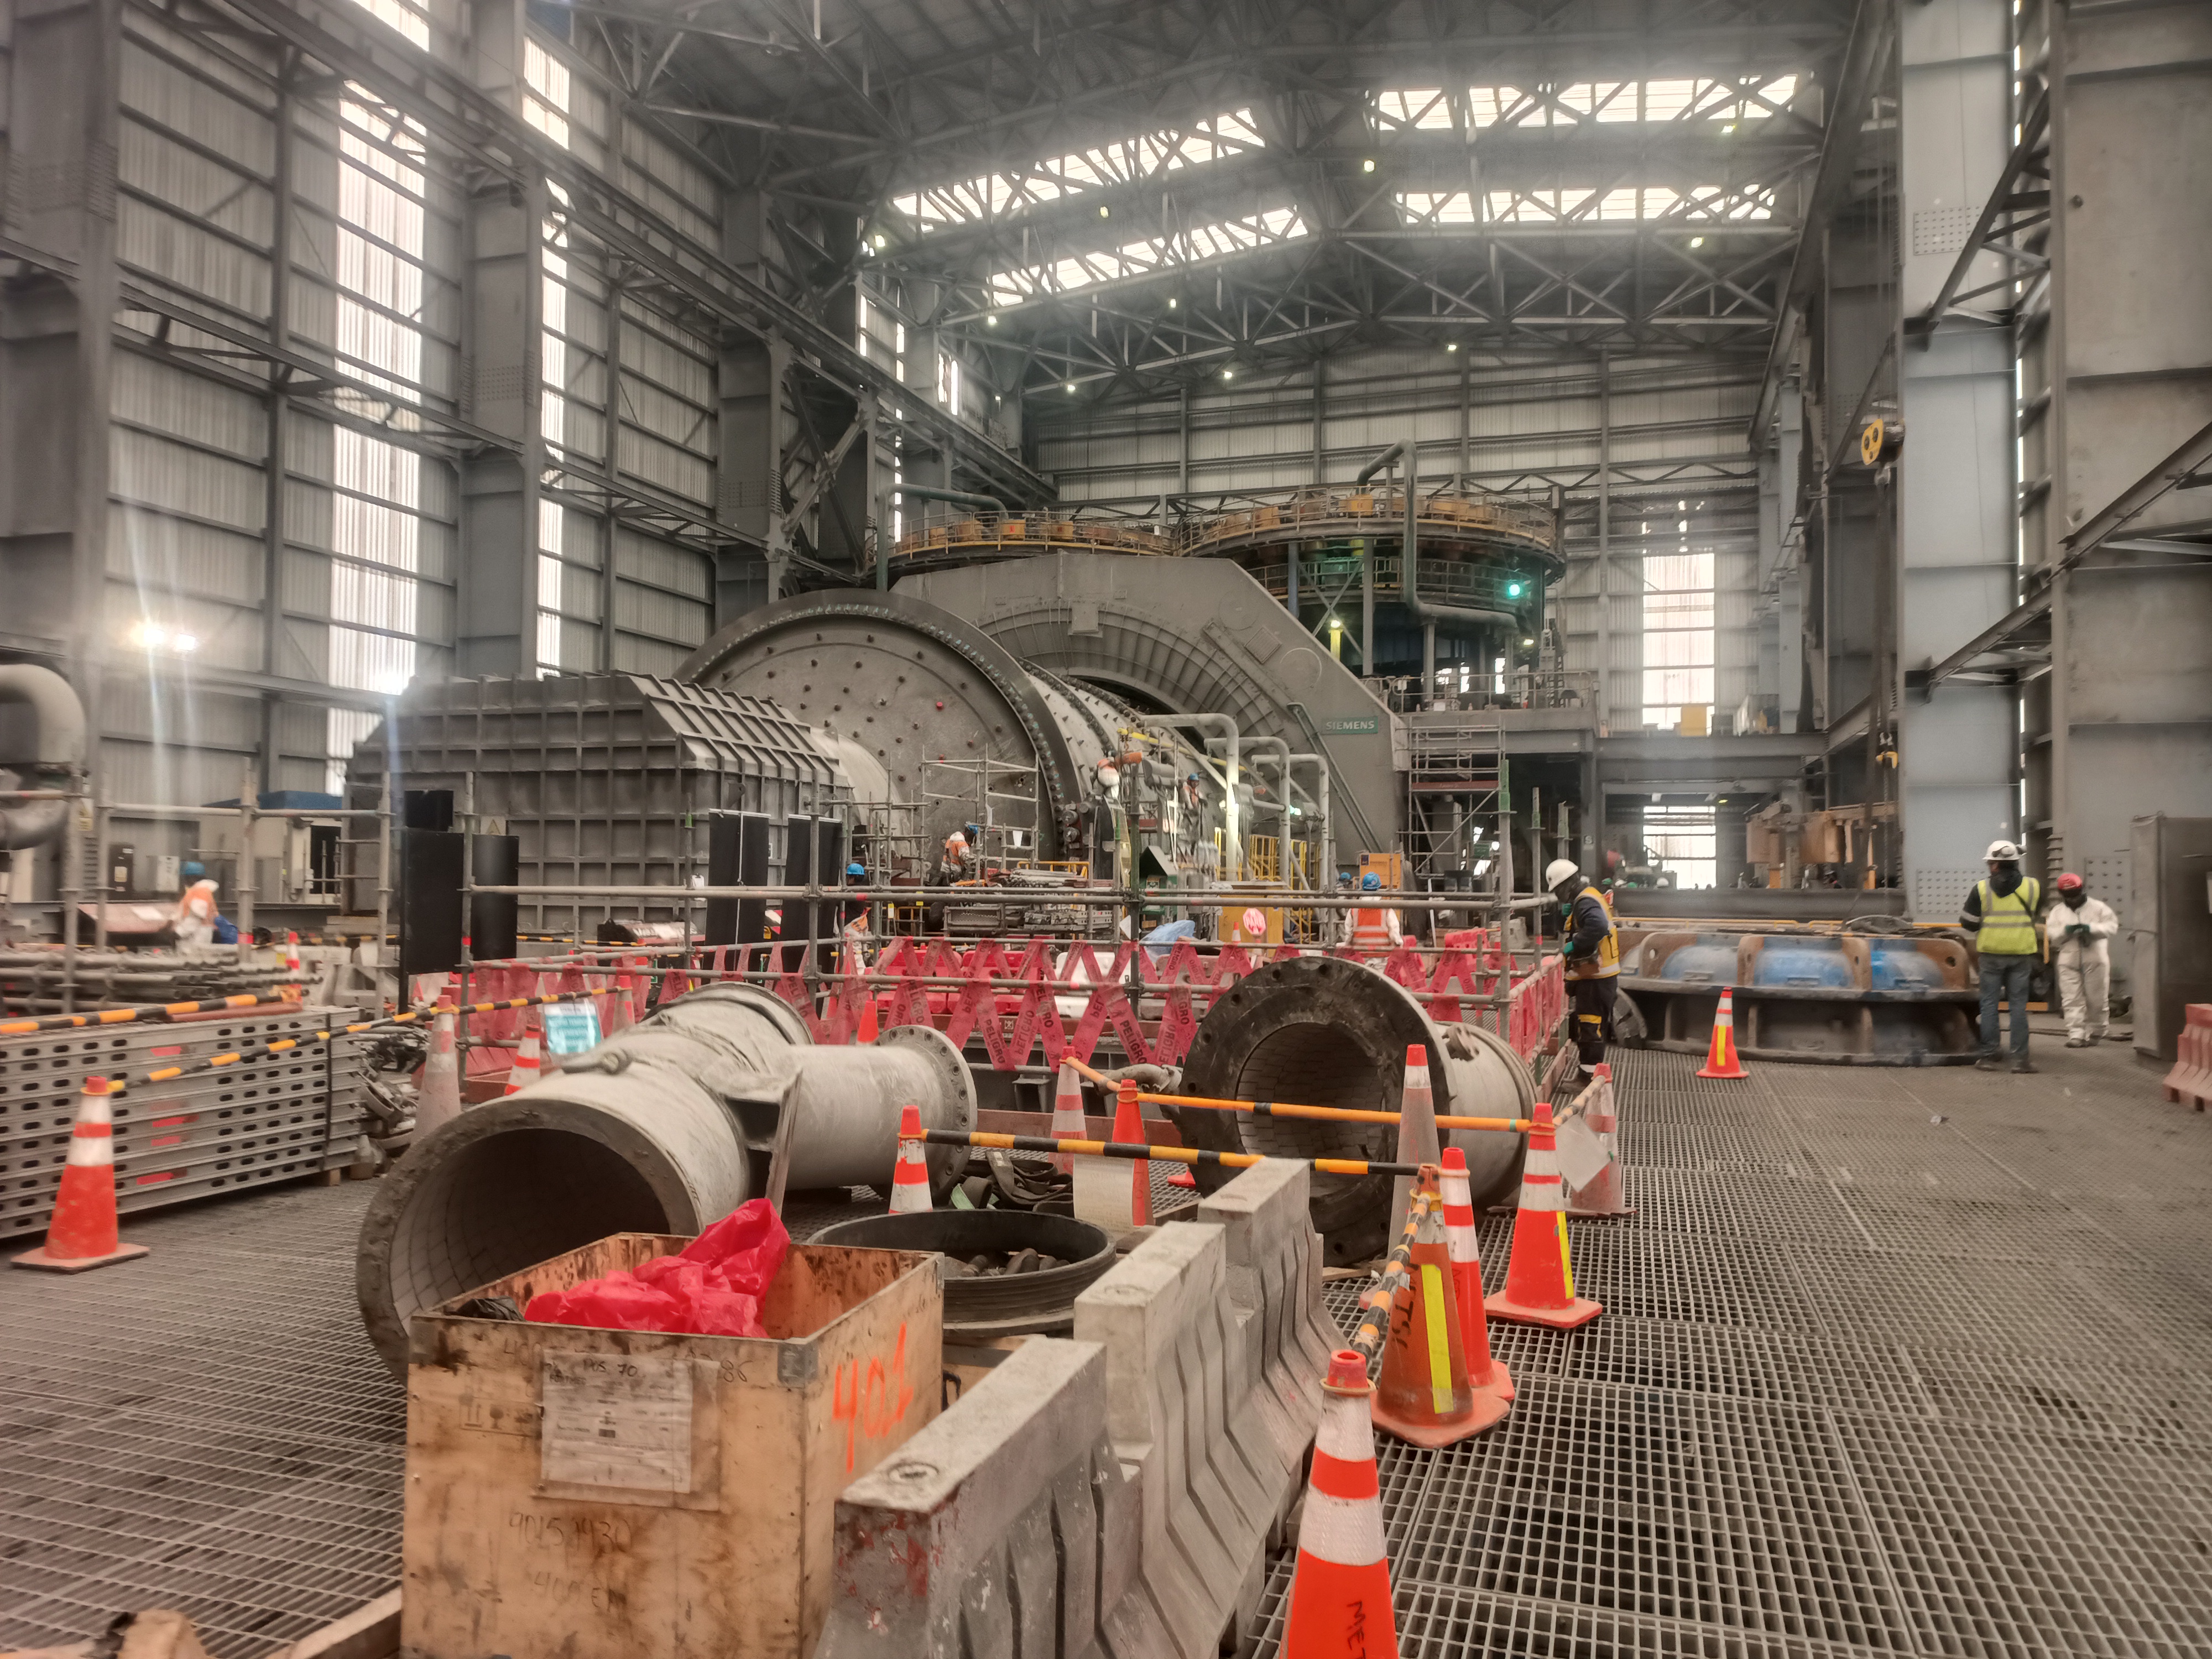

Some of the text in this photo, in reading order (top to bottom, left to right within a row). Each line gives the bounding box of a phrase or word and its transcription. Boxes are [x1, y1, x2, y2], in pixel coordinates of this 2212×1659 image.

[1326, 721, 1375, 730] SIEMENS
[1168, 943, 1185, 970] PELIGRO
[985, 1019, 1006, 1064] PELIGRO
[1119, 1020, 1147, 1065] PELIGRO
[618, 1363, 638, 1377] 70
[832, 1322, 914, 1474] 401
